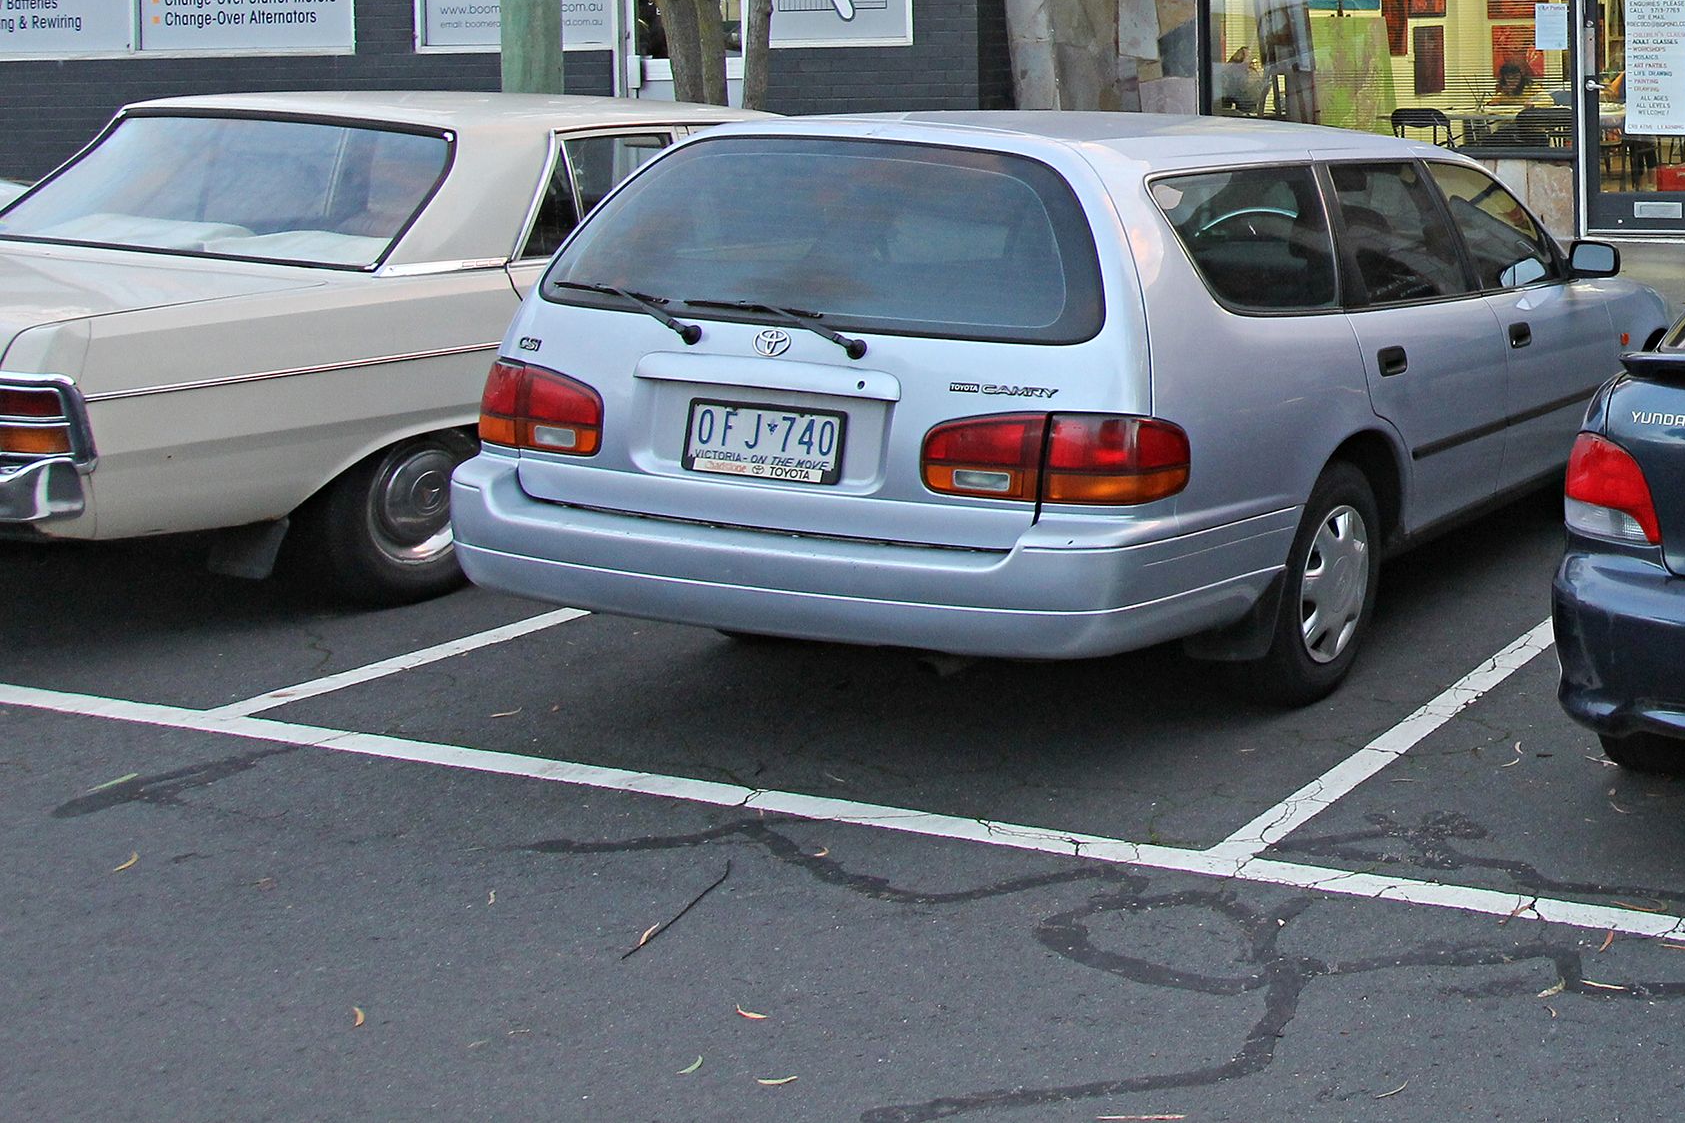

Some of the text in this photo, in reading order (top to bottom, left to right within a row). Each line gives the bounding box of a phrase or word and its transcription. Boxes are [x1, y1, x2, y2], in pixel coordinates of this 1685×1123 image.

[19, 15, 28, 30] &
[32, 14, 82, 32] Rewiring
[164, 8, 317, 29] Change-Over Alternators
[950, 383, 1059, 398] TOYOTA CAMRY
[781, 415, 835, 457] 740
[750, 454, 768, 465] ON
[771, 456, 794, 466] THE
[795, 459, 830, 470] MOVE
[769, 466, 811, 481] TOYOTA
